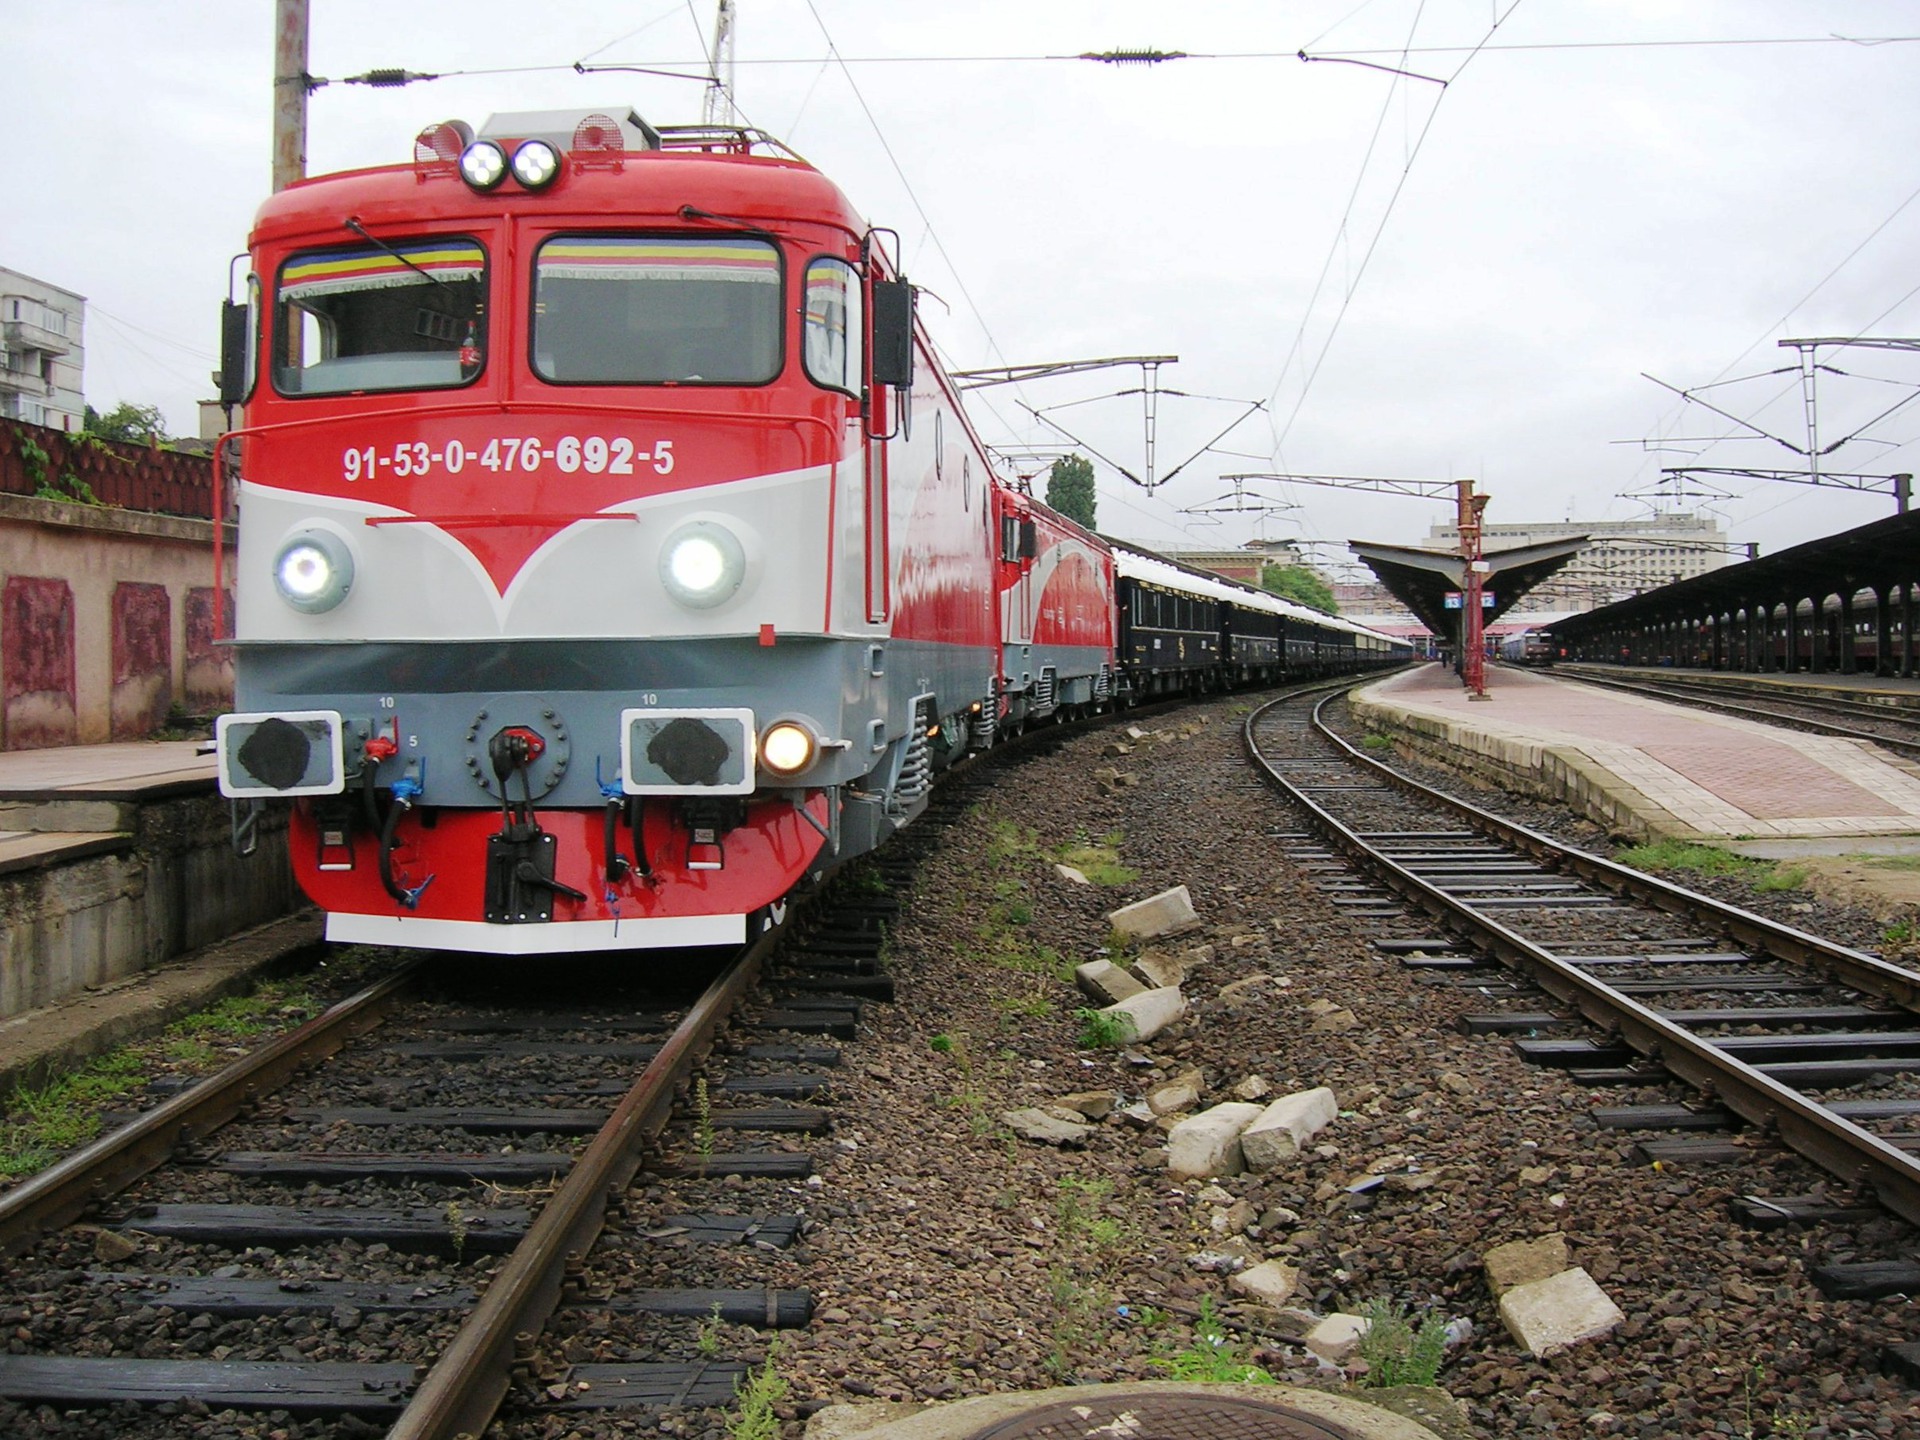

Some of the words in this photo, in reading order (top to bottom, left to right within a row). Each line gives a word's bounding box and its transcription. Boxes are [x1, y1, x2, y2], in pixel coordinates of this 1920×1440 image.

[343, 436, 675, 481] 91-53-0-476-692-5
[1447, 598, 1459, 608] 13
[379, 697, 394, 708] 10
[642, 694, 657, 705] 10
[409, 735, 418, 747] 5
